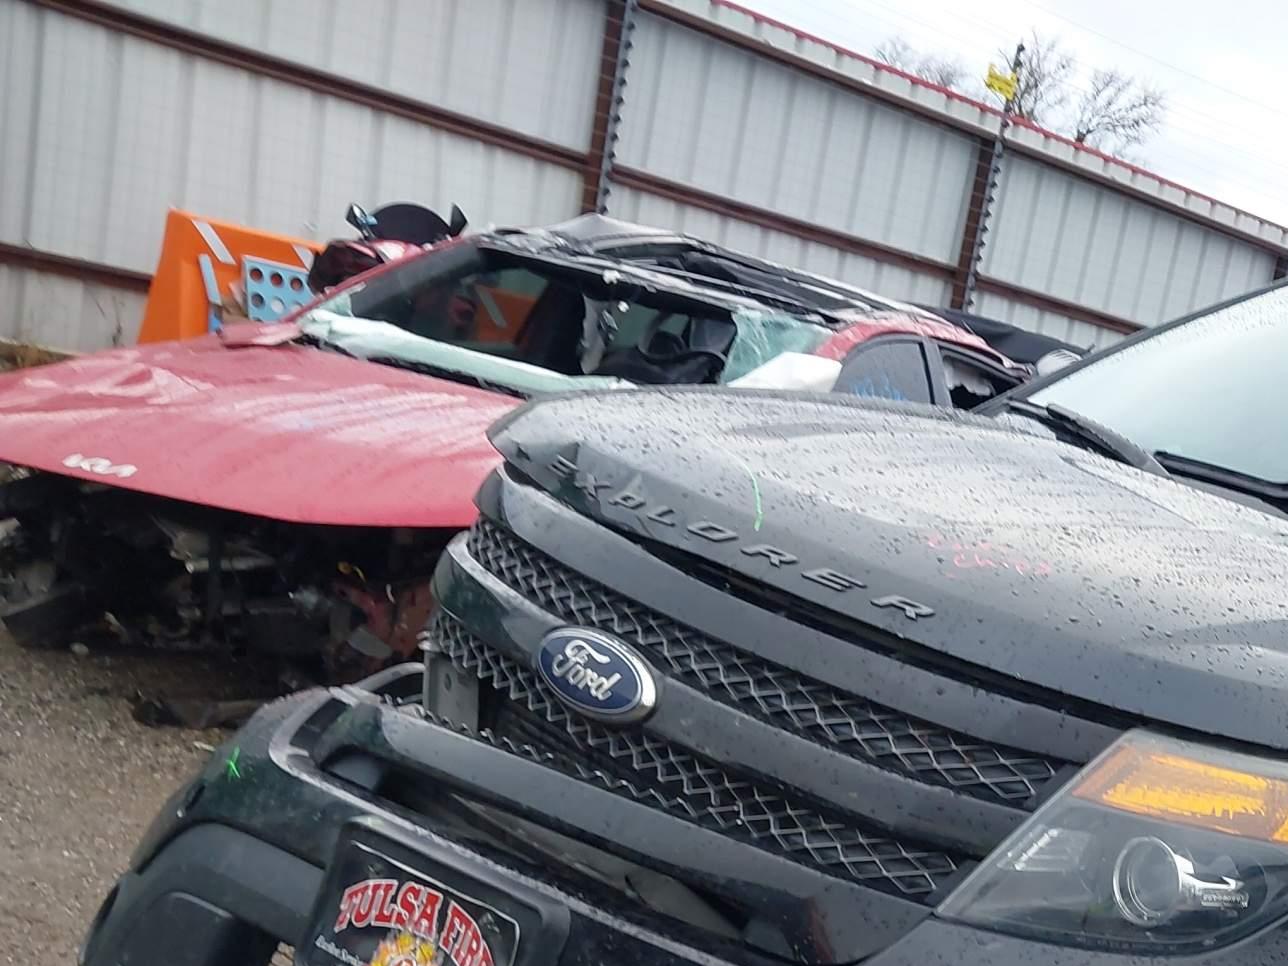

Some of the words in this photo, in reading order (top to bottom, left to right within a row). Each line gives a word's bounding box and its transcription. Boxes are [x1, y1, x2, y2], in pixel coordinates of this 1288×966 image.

[548, 454, 937, 622] EXPLORER
[549, 638, 624, 702] Ford
[333, 879, 444, 941] TULSA
